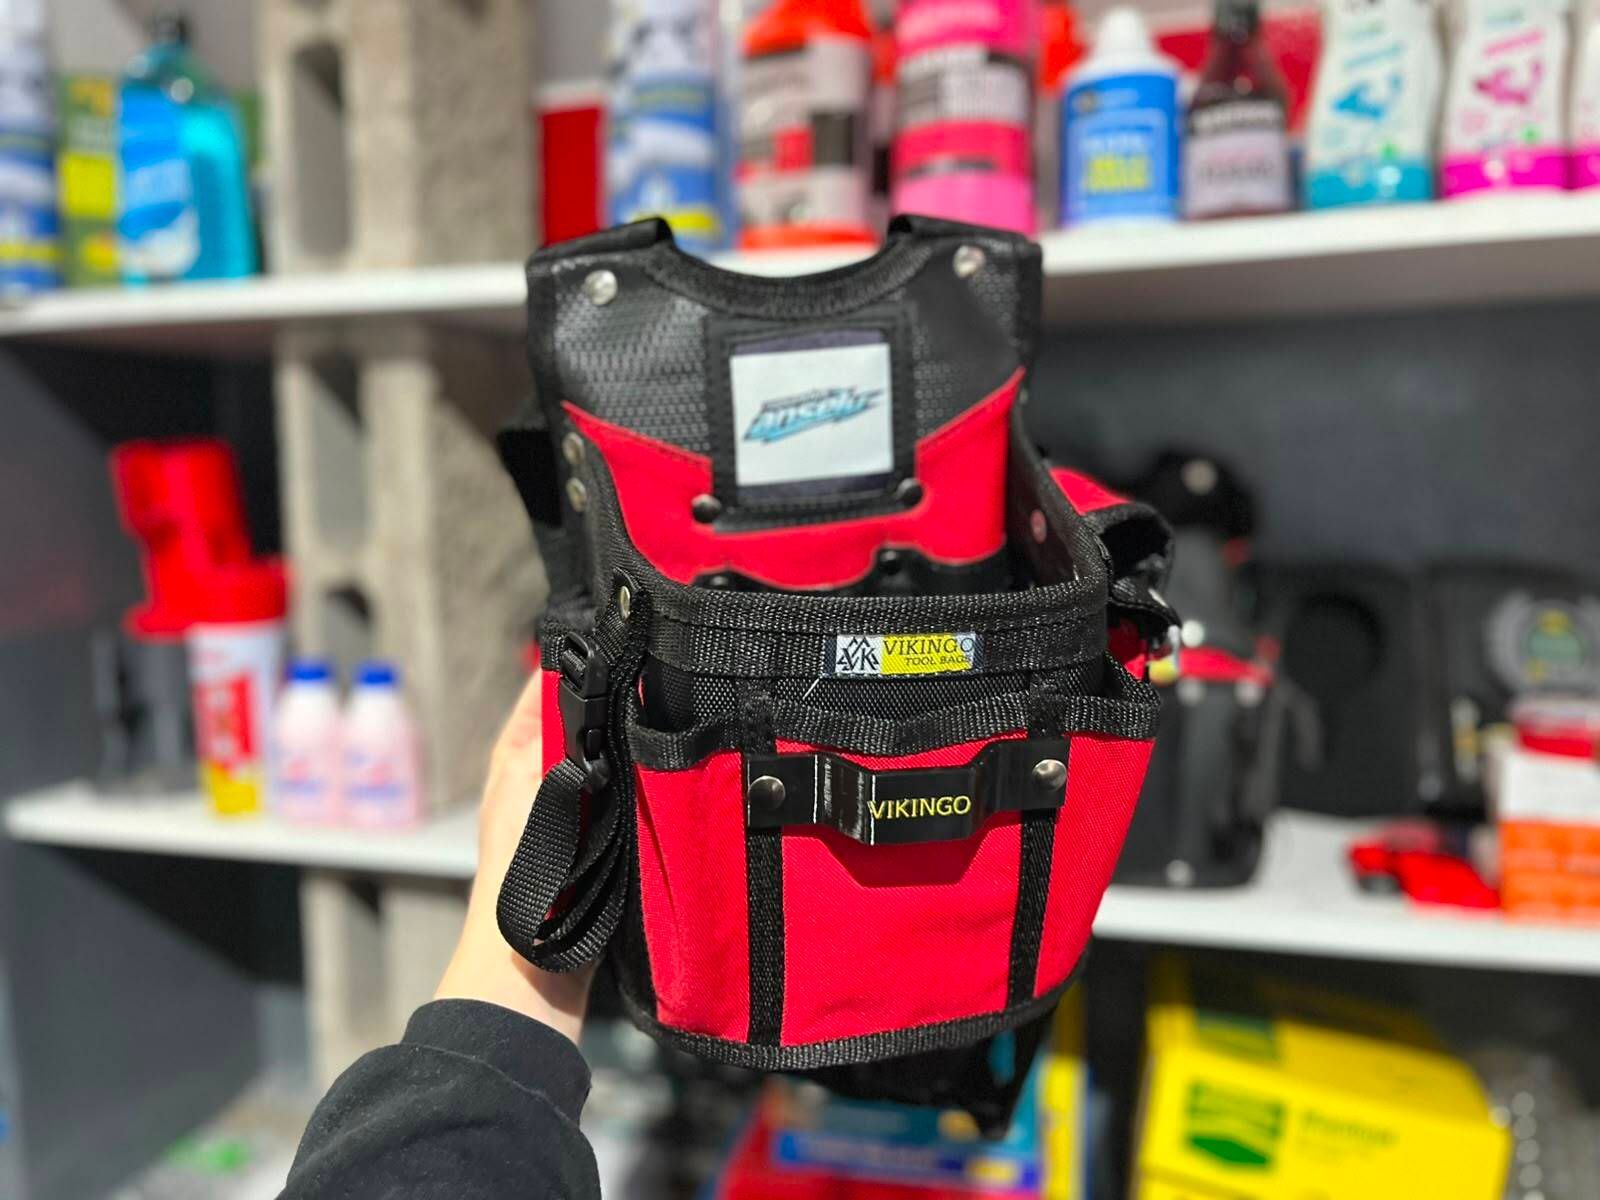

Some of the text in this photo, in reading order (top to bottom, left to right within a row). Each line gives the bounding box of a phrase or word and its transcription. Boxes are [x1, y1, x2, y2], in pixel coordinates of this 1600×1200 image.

[884, 637, 973, 656] VIKINGO
[906, 656, 936, 666] TOOL
[867, 795, 971, 819] VIKINGO
